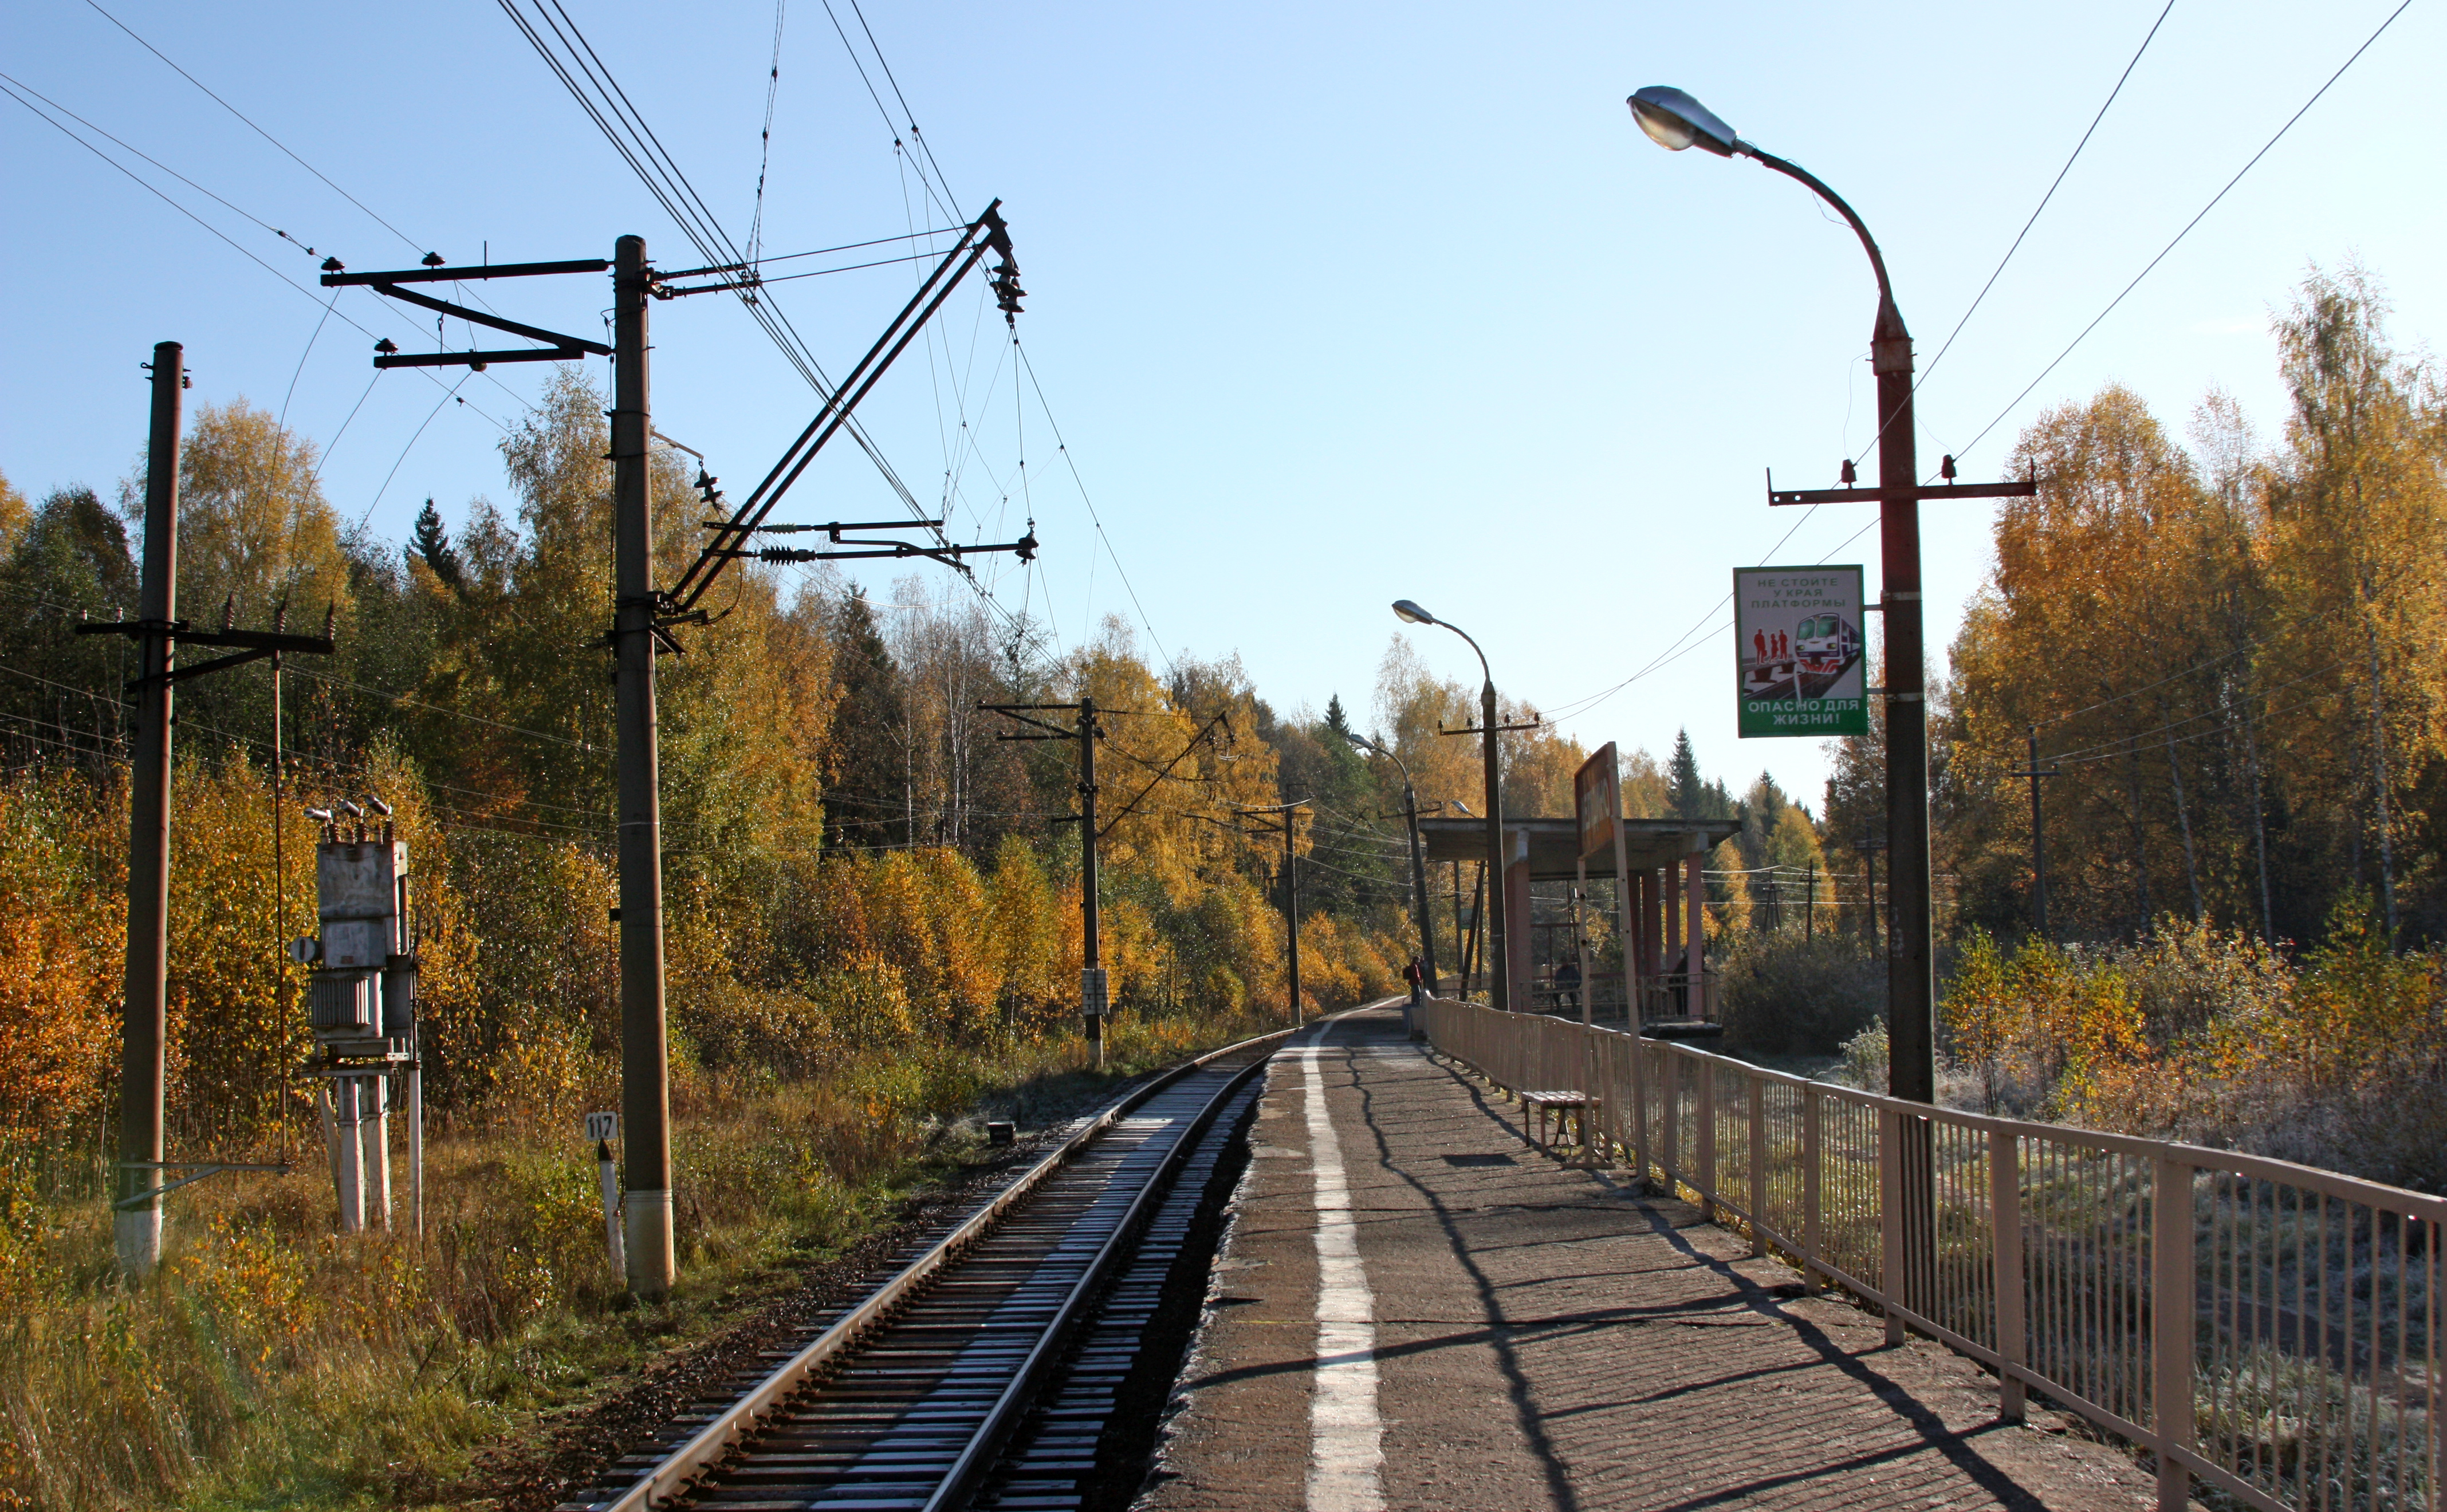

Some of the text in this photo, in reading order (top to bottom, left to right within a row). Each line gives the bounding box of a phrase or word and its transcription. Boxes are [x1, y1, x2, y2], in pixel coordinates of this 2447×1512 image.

[1757, 577, 1838, 587] НЕ СТОЙТЕ
[1774, 589, 1823, 597] У КРАЯ
[1752, 599, 1846, 608] ПЛАТФОРМЫ
[1748, 700, 1859, 712] ОПАСНО ДЛЯ
[1773, 714, 1840, 725] ЖИЗНИ!
